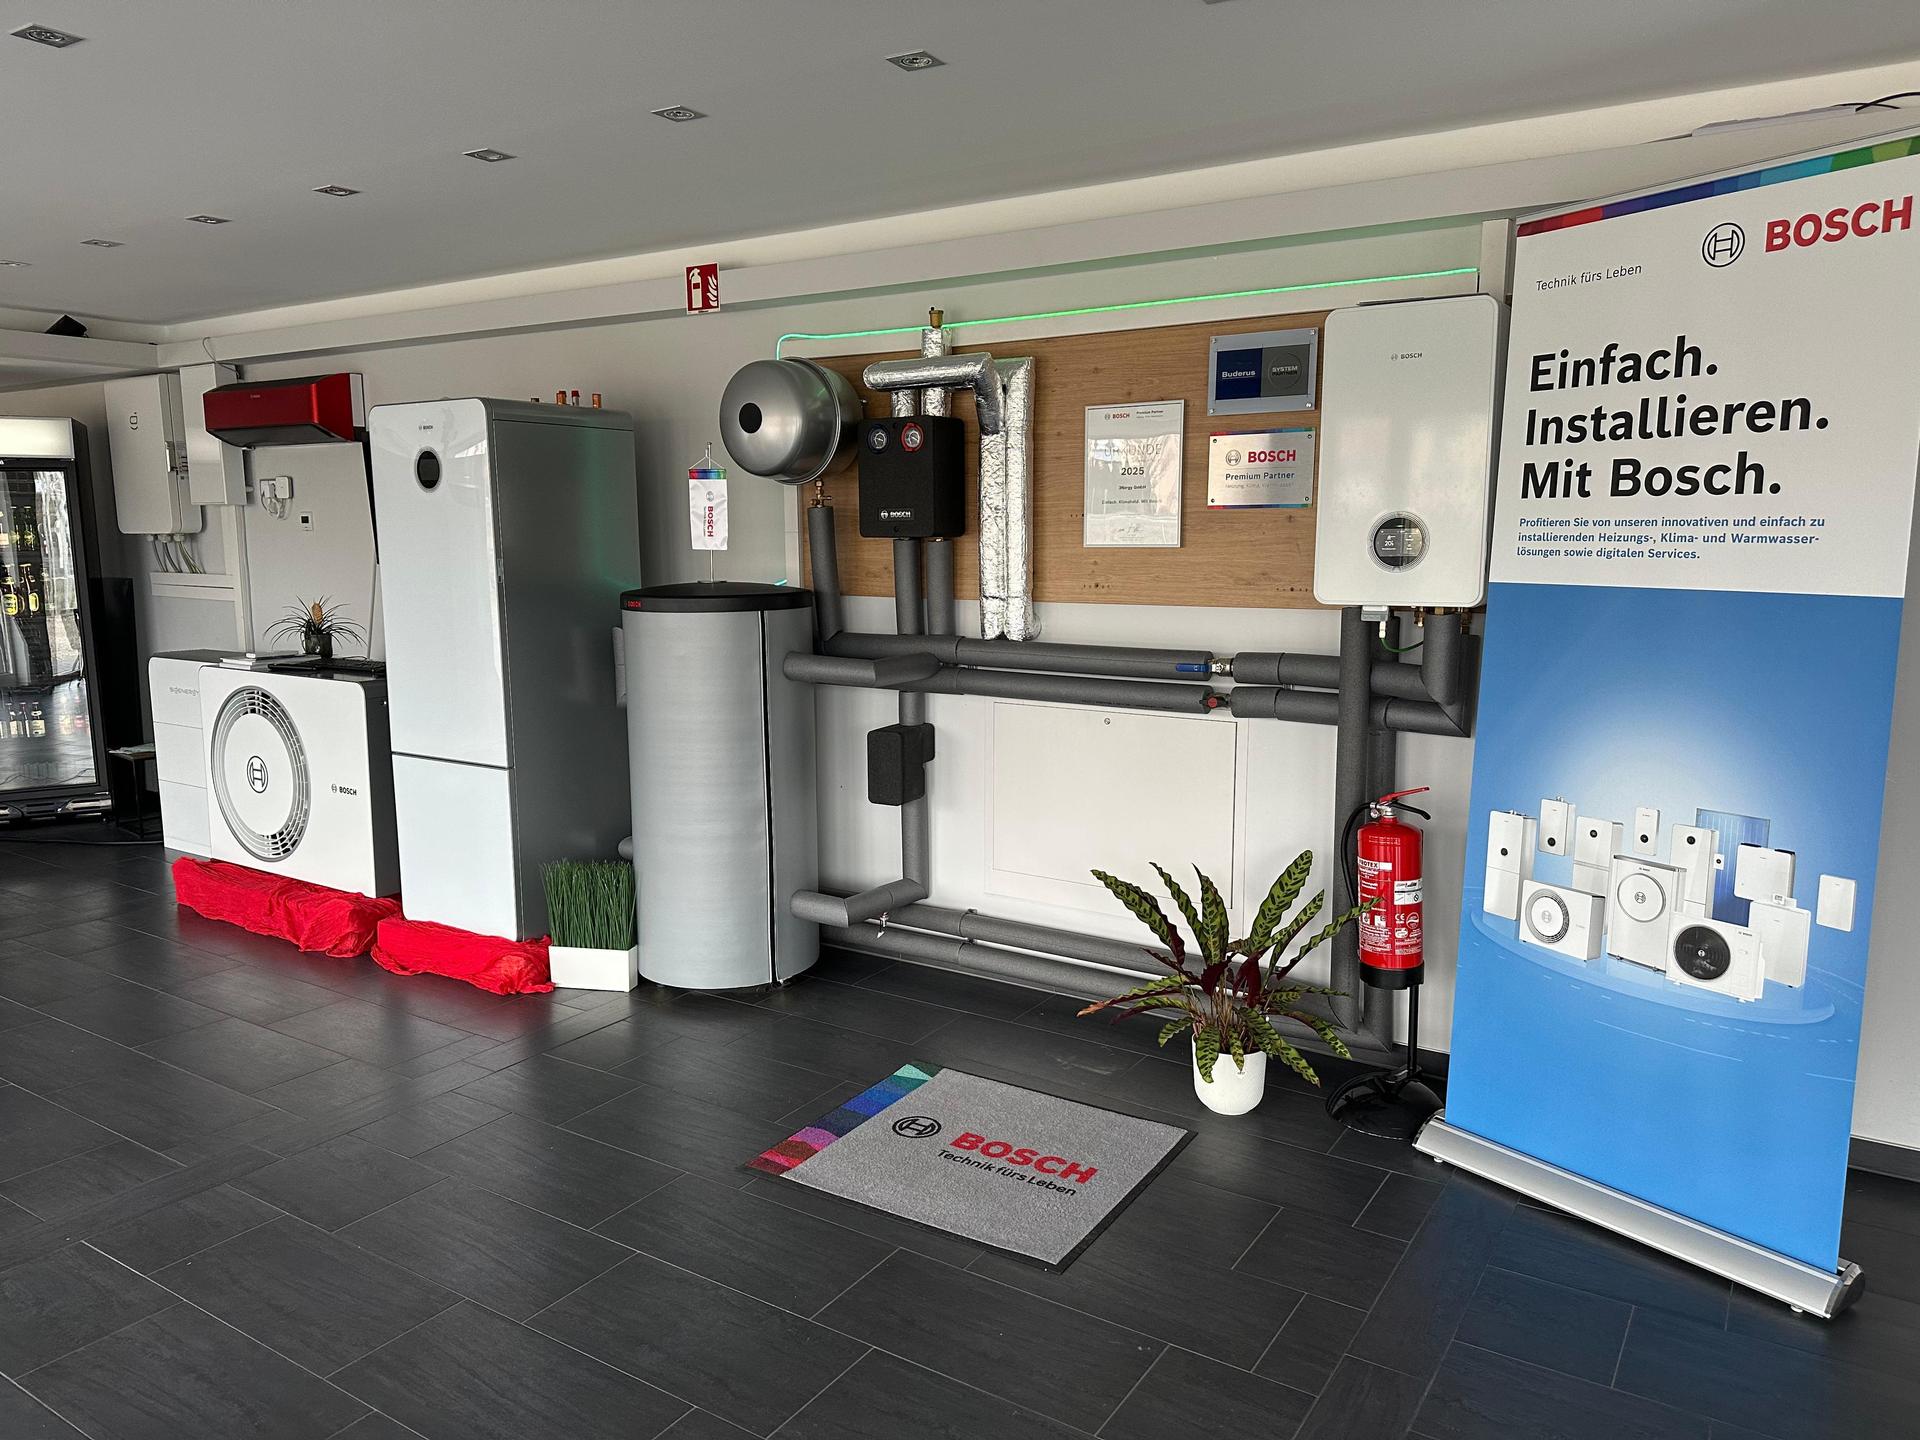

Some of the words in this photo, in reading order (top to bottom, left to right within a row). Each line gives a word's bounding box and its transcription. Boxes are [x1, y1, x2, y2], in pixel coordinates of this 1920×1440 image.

[1764, 195, 1913, 253] BOSCH
[1536, 275, 1577, 291] Technik
[1580, 267, 1602, 284] fürs
[1606, 260, 1642, 280] Leben
[1400, 352, 1423, 360] BOSCH
[1272, 365, 1298, 373] SYSTEM
[1529, 335, 1718, 392] Einfach.
[1222, 370, 1256, 378] Buderus
[1525, 394, 1829, 446] Installieren.
[1247, 450, 1296, 463] BOSCH
[1121, 467, 1145, 476] 2025
[1225, 473, 1261, 481] Premium
[1263, 471, 1295, 480] Partner
[1521, 458, 1592, 500] Mit
[1609, 451, 1783, 498] Bosch.
[1519, 517, 1571, 528] Profitieren
[1573, 517, 1589, 527] Sie
[1592, 519, 1611, 527] von
[1614, 519, 1658, 527] unseren
[1661, 516, 1729, 527] innovativen
[1732, 516, 1756, 527] und
[1760, 516, 1806, 527] einfach
[1809, 519, 1825, 527] zu
[1518, 532, 1595, 543] installierenden
[1598, 532, 1657, 545] Heizungs-,
[1660, 532, 1699, 543] Klima-
[1702, 533, 1726, 543] und
[1731, 533, 1820, 544] Warmwasser-
[1517, 547, 1561, 559] lösungen
[1563, 547, 1593, 557] sowie
[1596, 548, 1644, 560] digitalen
[1647, 548, 1701, 559] Services.
[339, 785, 357, 796] BOSCH
[950, 1132, 1099, 1184] BOSCH
[937, 1149, 996, 1172] Technik
[995, 1166, 1028, 1183] fürs
[1026, 1175, 1077, 1197] Leben
